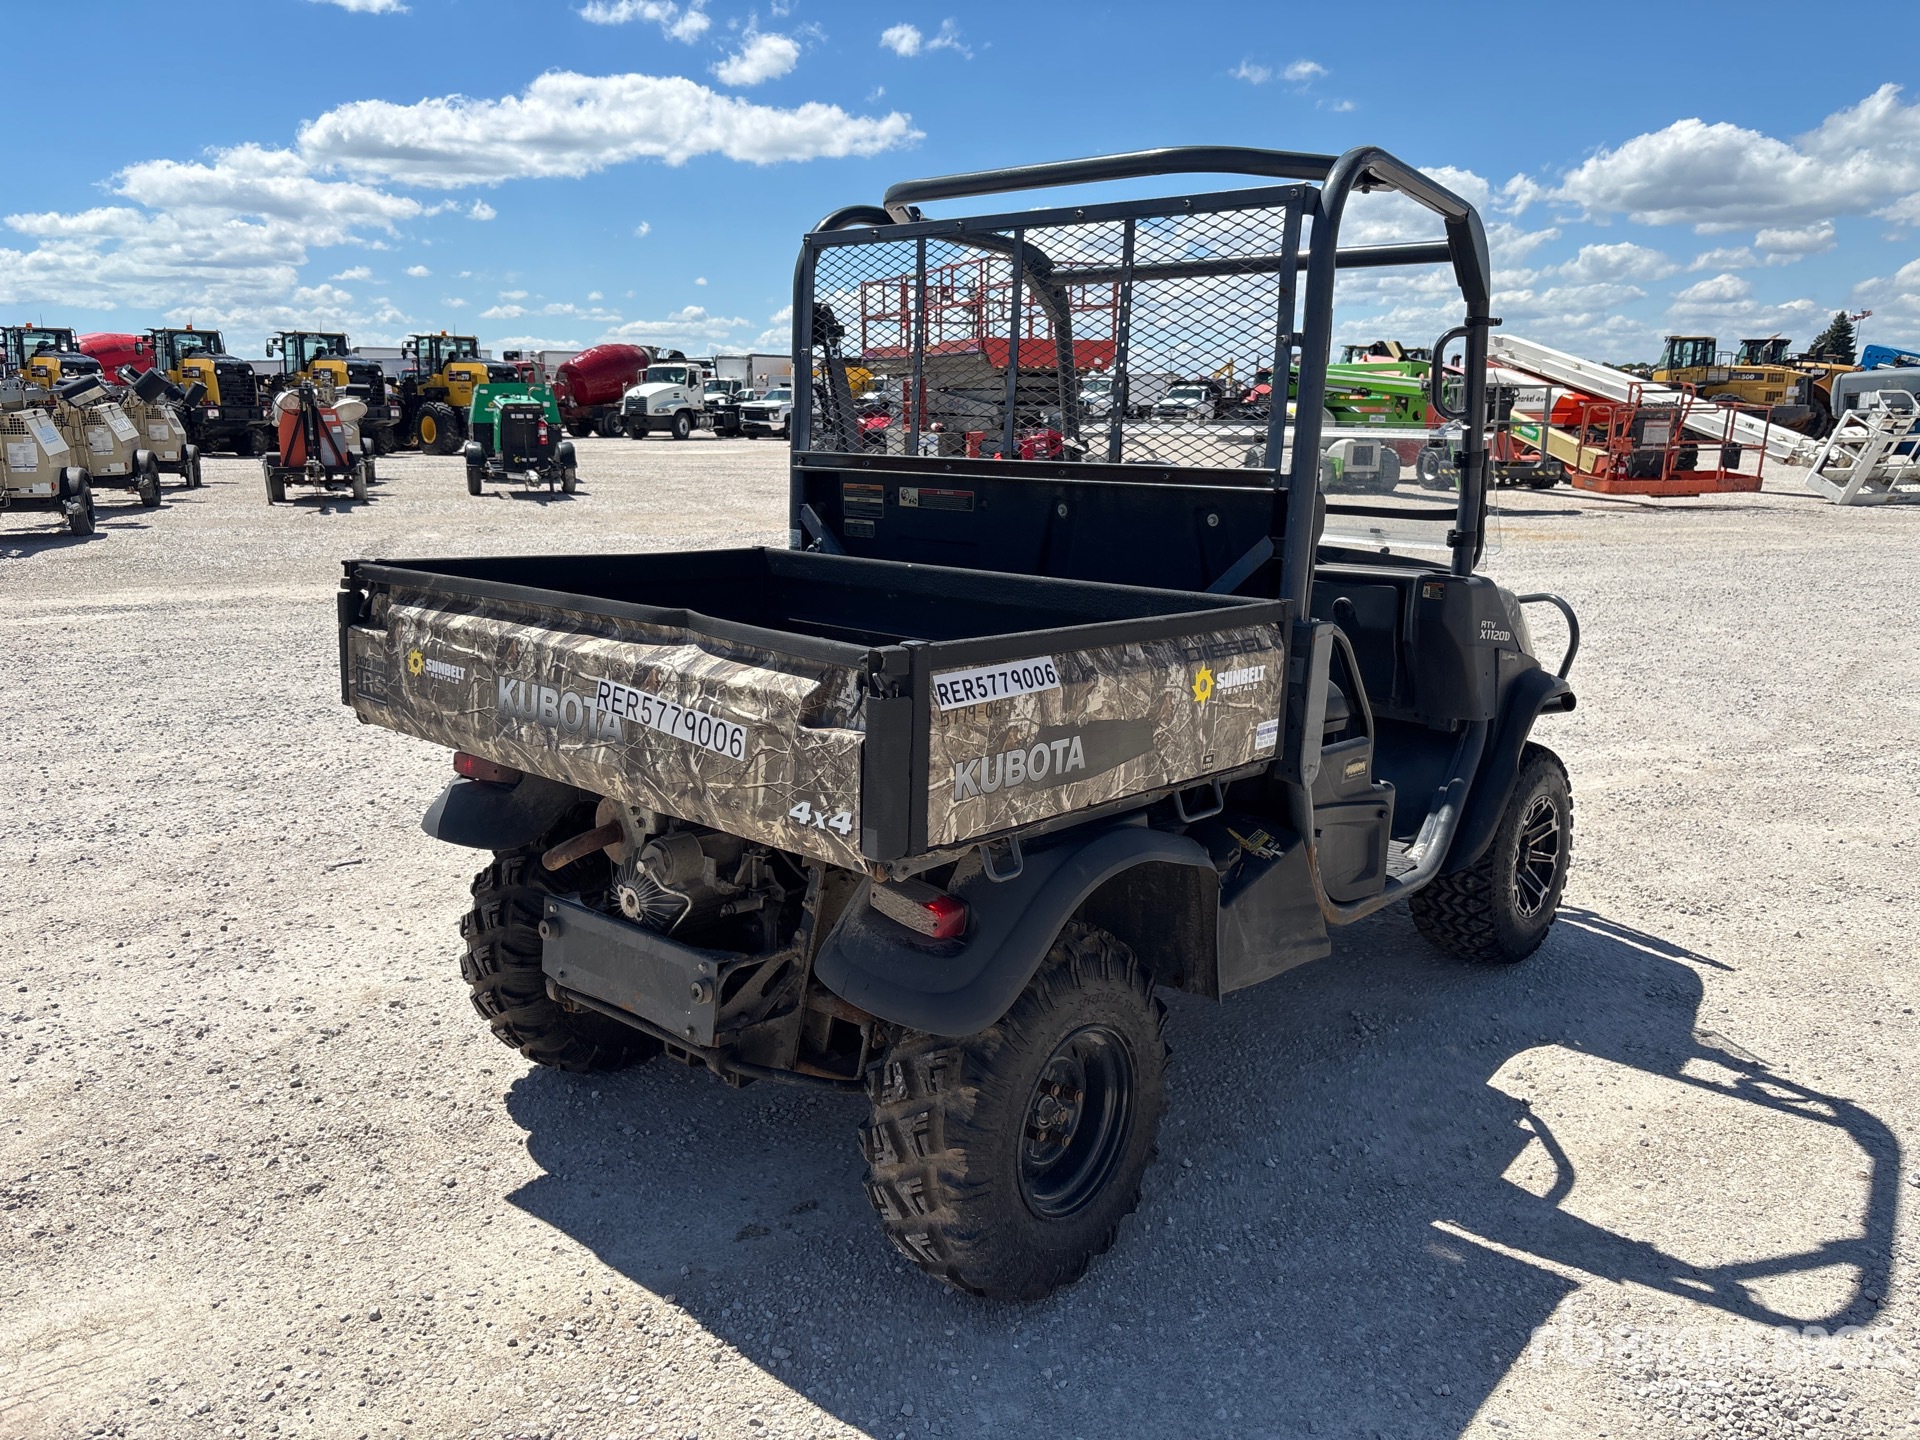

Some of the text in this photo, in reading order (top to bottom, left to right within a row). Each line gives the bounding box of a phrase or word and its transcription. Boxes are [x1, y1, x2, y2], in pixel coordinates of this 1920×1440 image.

[1479, 629, 1511, 642] X1120D
[1480, 620, 1497, 629] RTV
[1182, 637, 1273, 663] DIESEL
[425, 658, 466, 681] SUNBELT
[430, 672, 460, 685] RENTALS
[1216, 664, 1266, 690] SUNBELT
[937, 663, 1056, 705] RER5779006
[1221, 682, 1258, 696] RENTALS
[498, 675, 626, 747] KUBOTA
[596, 680, 744, 758] RER5779006
[953, 735, 1086, 802] KUBOTA
[788, 801, 852, 835] 4x4
